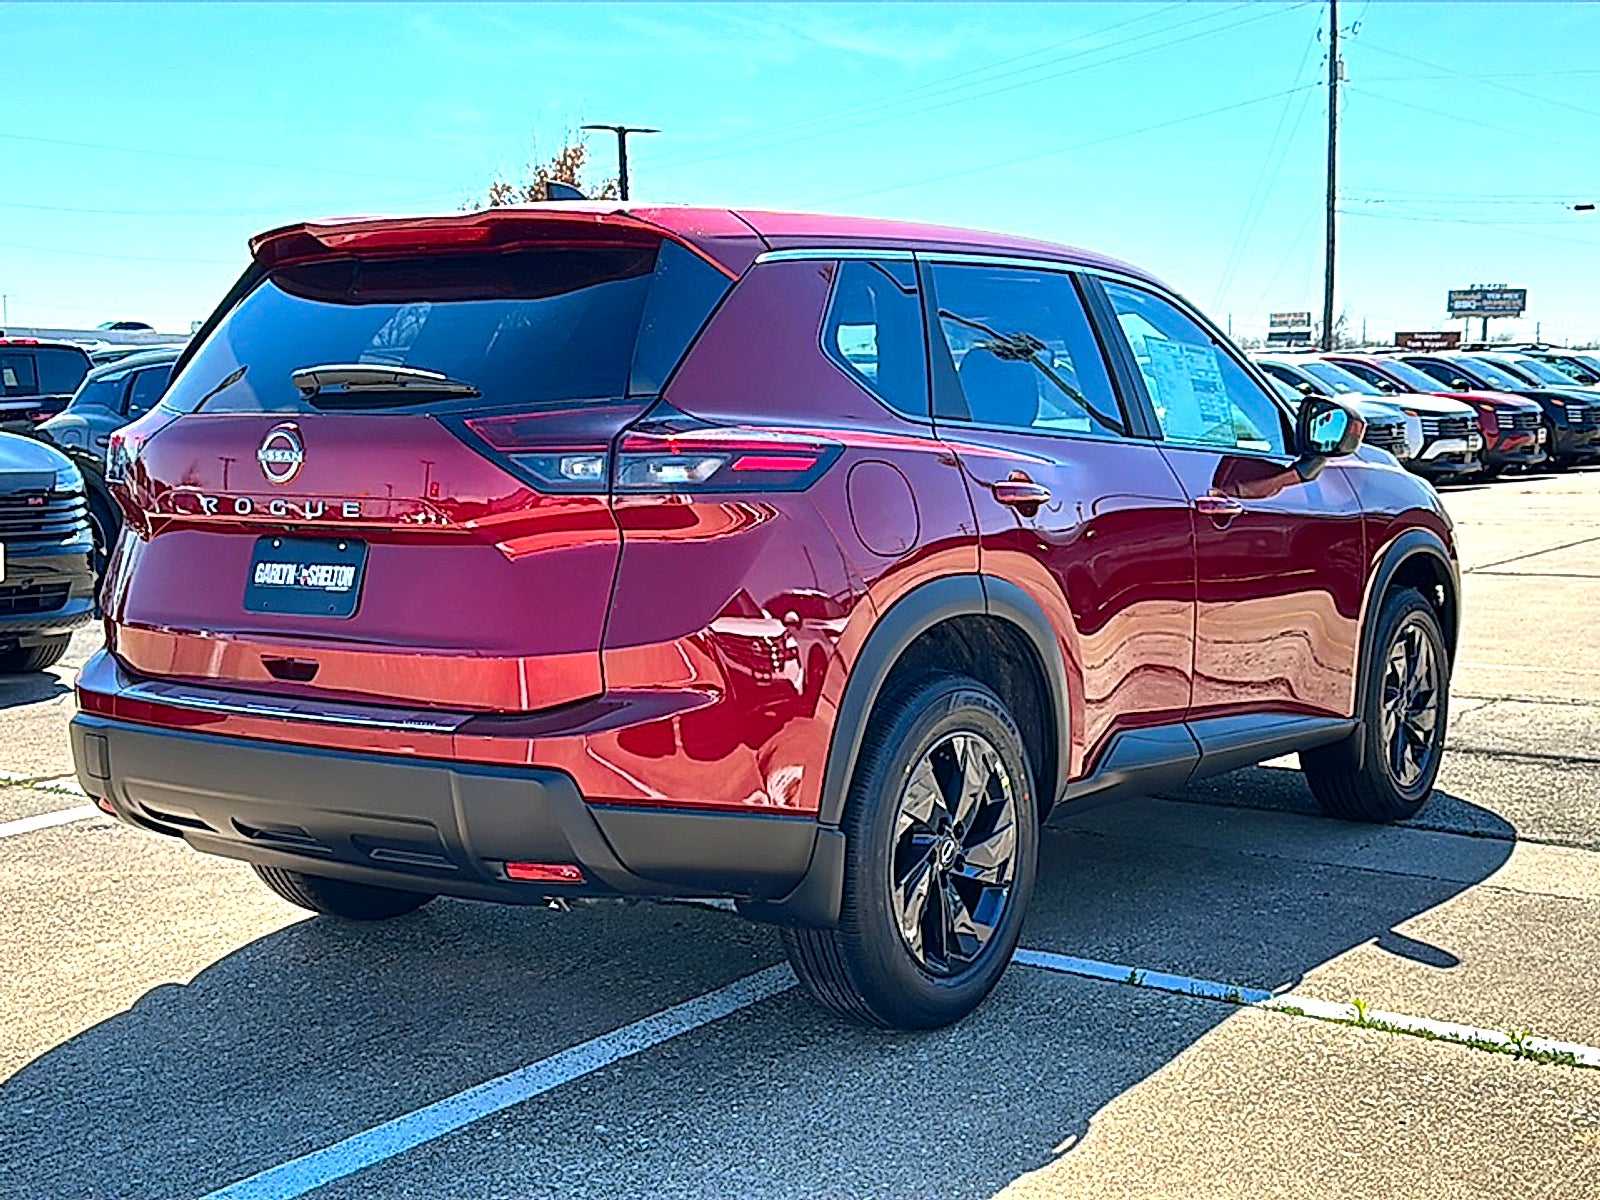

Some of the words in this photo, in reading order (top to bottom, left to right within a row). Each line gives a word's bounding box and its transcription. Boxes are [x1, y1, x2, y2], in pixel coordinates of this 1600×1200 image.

[257, 449, 303, 462] NISSAN
[203, 497, 360, 517] ROGUE
[308, 564, 356, 587] SHELTON
